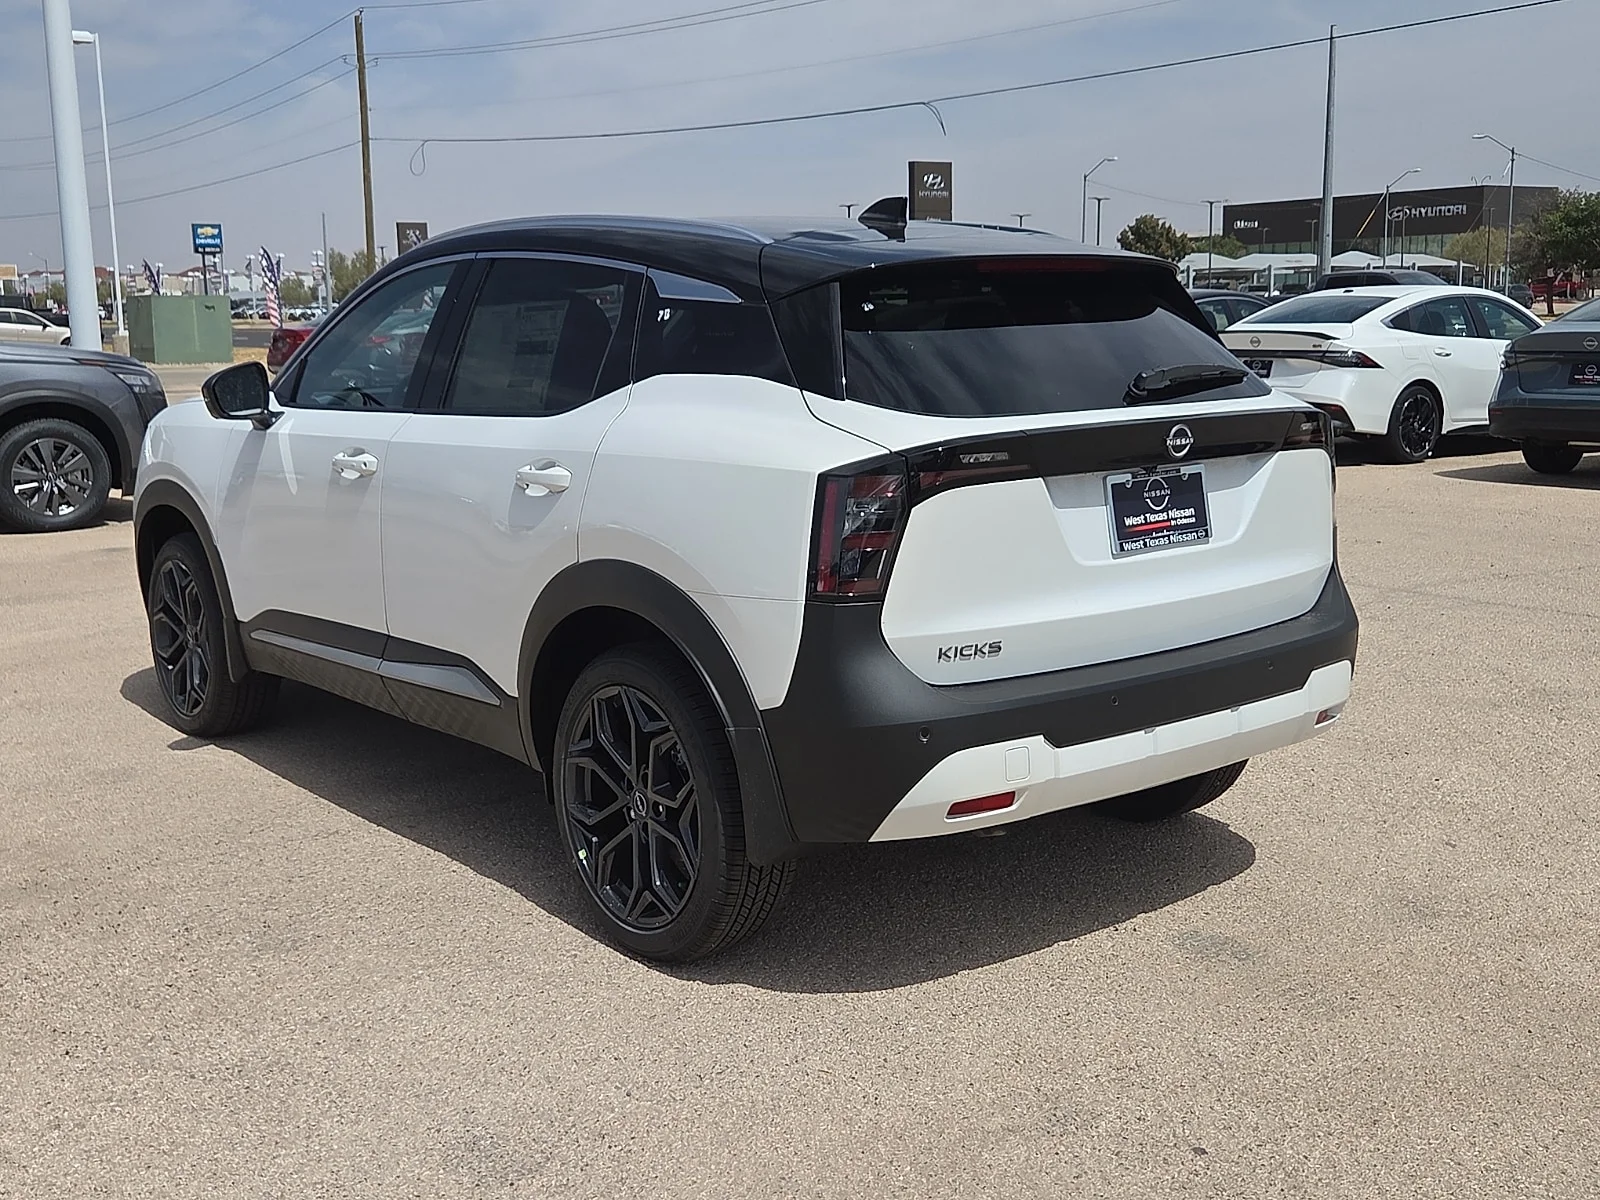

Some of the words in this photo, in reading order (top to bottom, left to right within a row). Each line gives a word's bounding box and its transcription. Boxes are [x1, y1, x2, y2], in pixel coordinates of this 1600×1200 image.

[1411, 204, 1467, 218] HYUNDAI
[1166, 437, 1194, 446] NISSAN
[1143, 488, 1171, 498] NISSAN
[1124, 515, 1145, 527] West
[1145, 511, 1168, 522] Texas
[1168, 507, 1195, 518] Nissan
[1176, 517, 1196, 526] Odessa
[1122, 539, 1144, 551] West
[1145, 535, 1168, 546] Texas
[1170, 531, 1198, 543] Nissan
[937, 640, 1002, 663] KICKS
